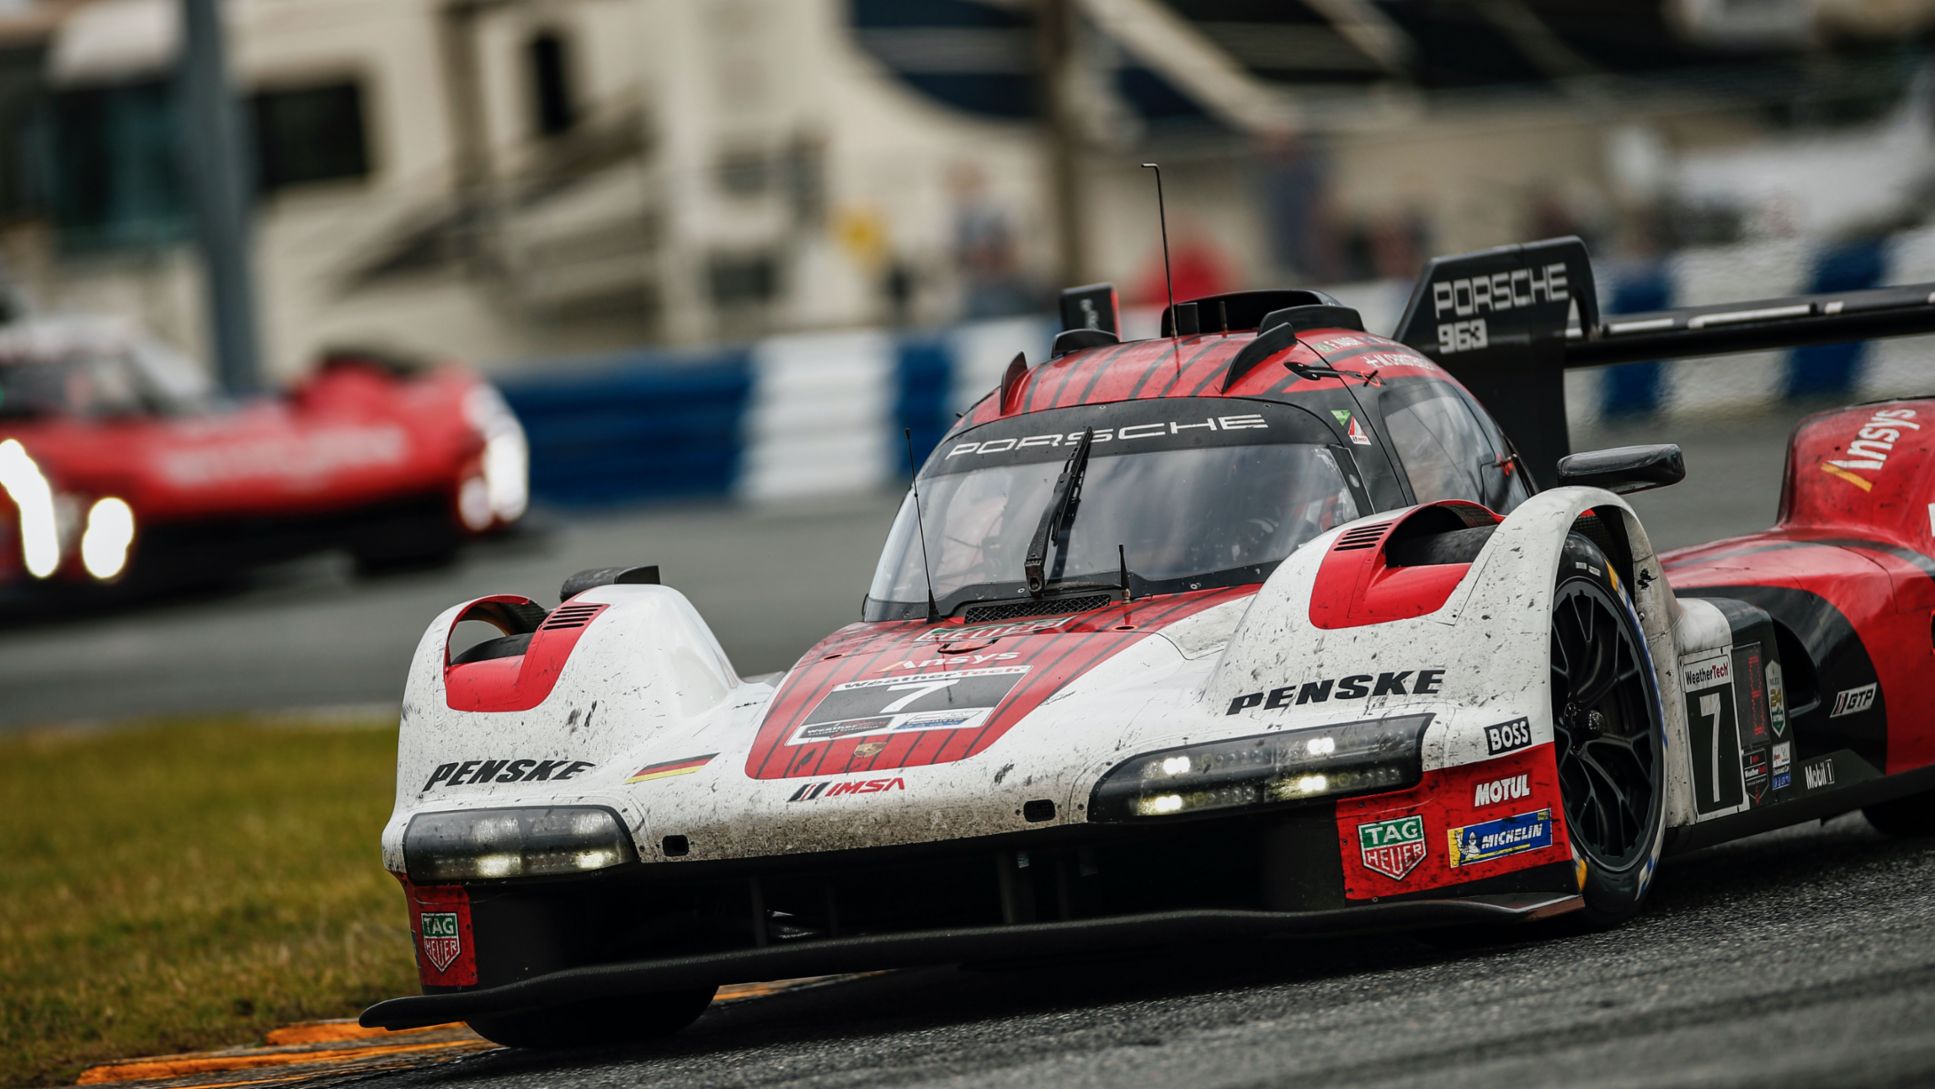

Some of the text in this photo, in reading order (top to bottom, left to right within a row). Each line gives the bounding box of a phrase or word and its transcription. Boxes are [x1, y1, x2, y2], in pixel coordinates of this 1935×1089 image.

[1433, 262, 1569, 319] PORSCHE
[1437, 318, 1489, 354] 963
[945, 414, 1269, 460] PORSCHE
[1820, 409, 1921, 493] Ansys
[879, 651, 1021, 672] Ansys
[1684, 662, 1729, 685] WeatherTech
[845, 668, 1021, 689] WeatherTech
[1226, 669, 1446, 716] PENSKE
[880, 679, 960, 714] 7
[1846, 689, 1874, 710] GTP
[1489, 721, 1528, 751] BOSS
[1699, 692, 1721, 803] 7
[422, 759, 597, 793] PENSKE
[825, 777, 905, 797] IMSA
[1474, 774, 1530, 807] MOTUL
[1805, 761, 1827, 790] Mobil
[1365, 821, 1418, 845] TAG
[1481, 823, 1543, 850] MICHELIN
[1367, 843, 1422, 875] HEUER
[423, 917, 454, 935] TAG
[425, 940, 457, 967] HEUER
